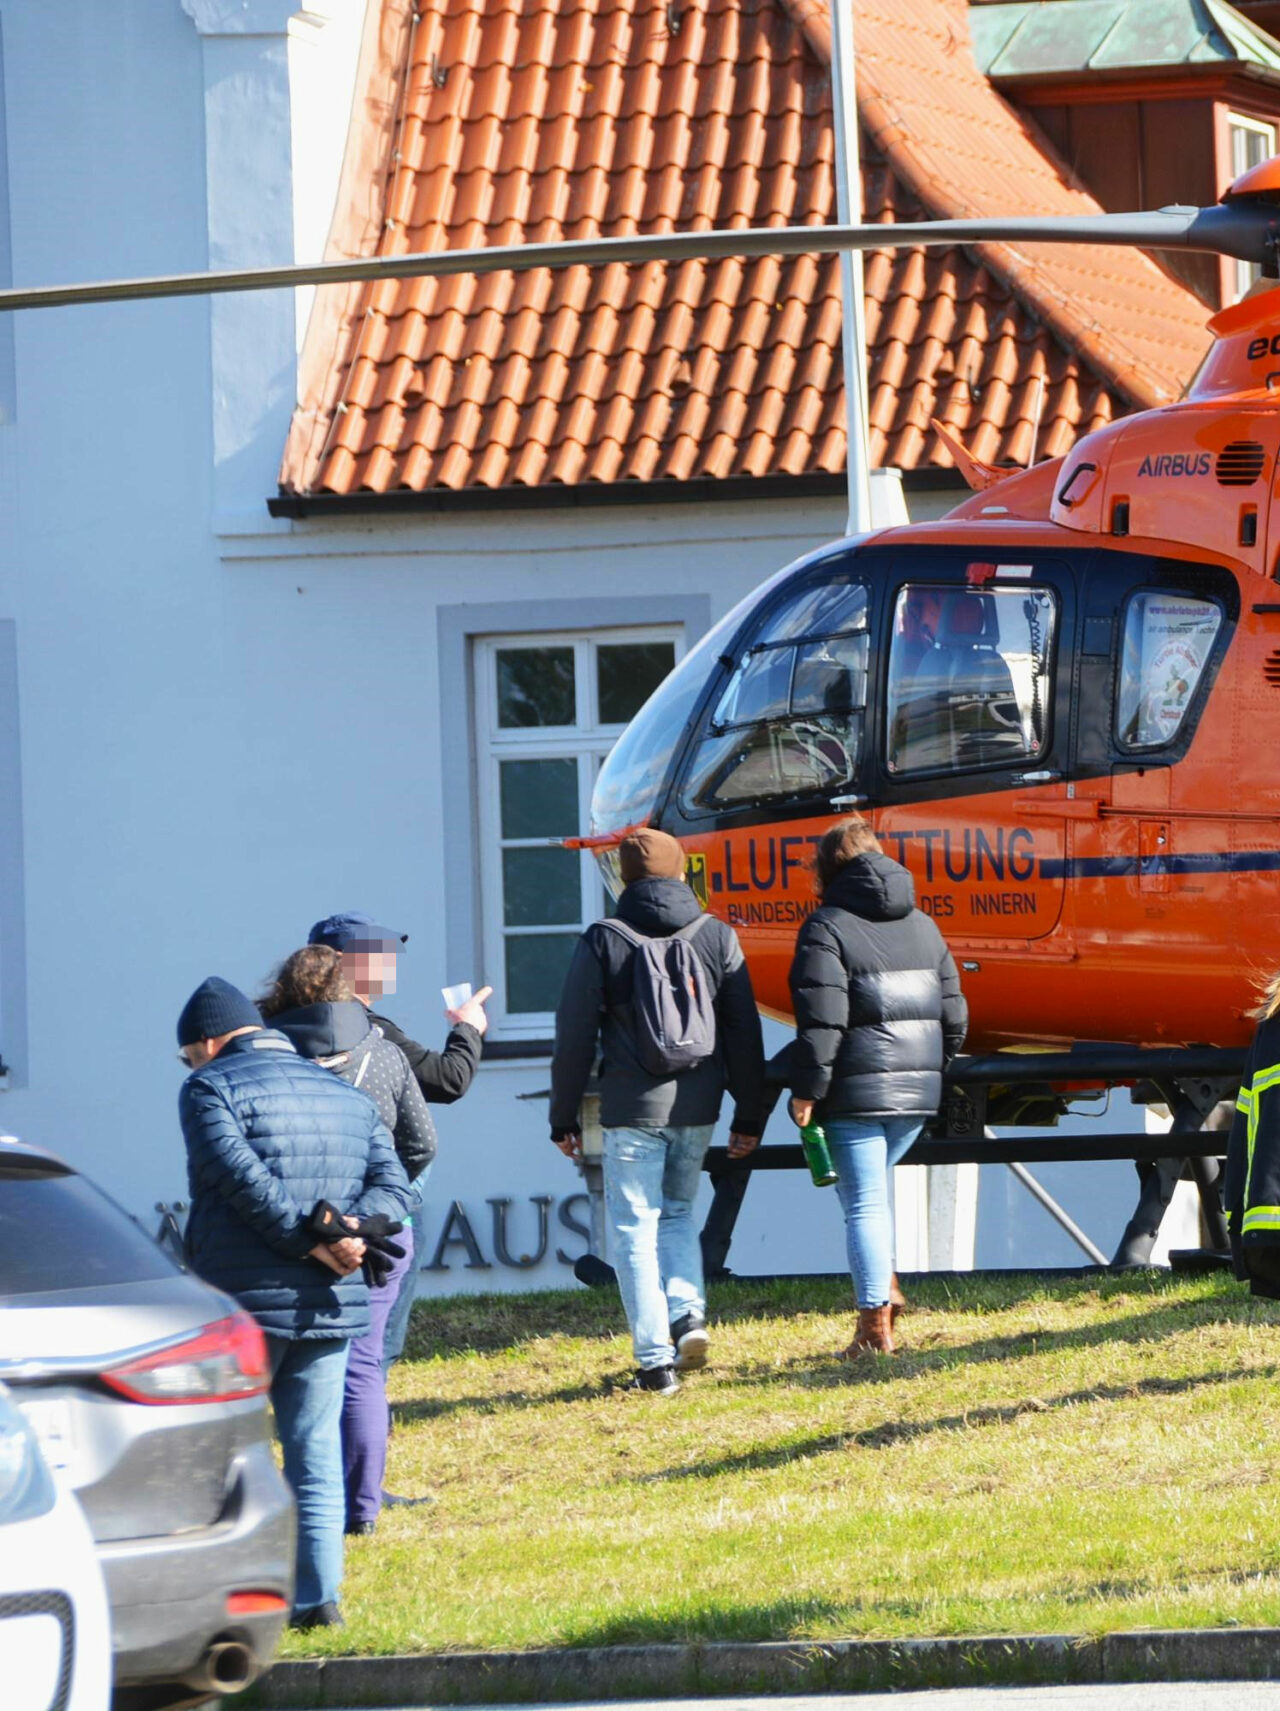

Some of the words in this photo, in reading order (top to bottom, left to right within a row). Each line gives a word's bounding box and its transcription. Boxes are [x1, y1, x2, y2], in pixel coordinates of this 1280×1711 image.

[1137, 453, 1212, 477] AIRBUS
[724, 827, 1035, 892] LUFTTUNG
[923, 895, 954, 917] DES
[970, 893, 1036, 916] INNERN
